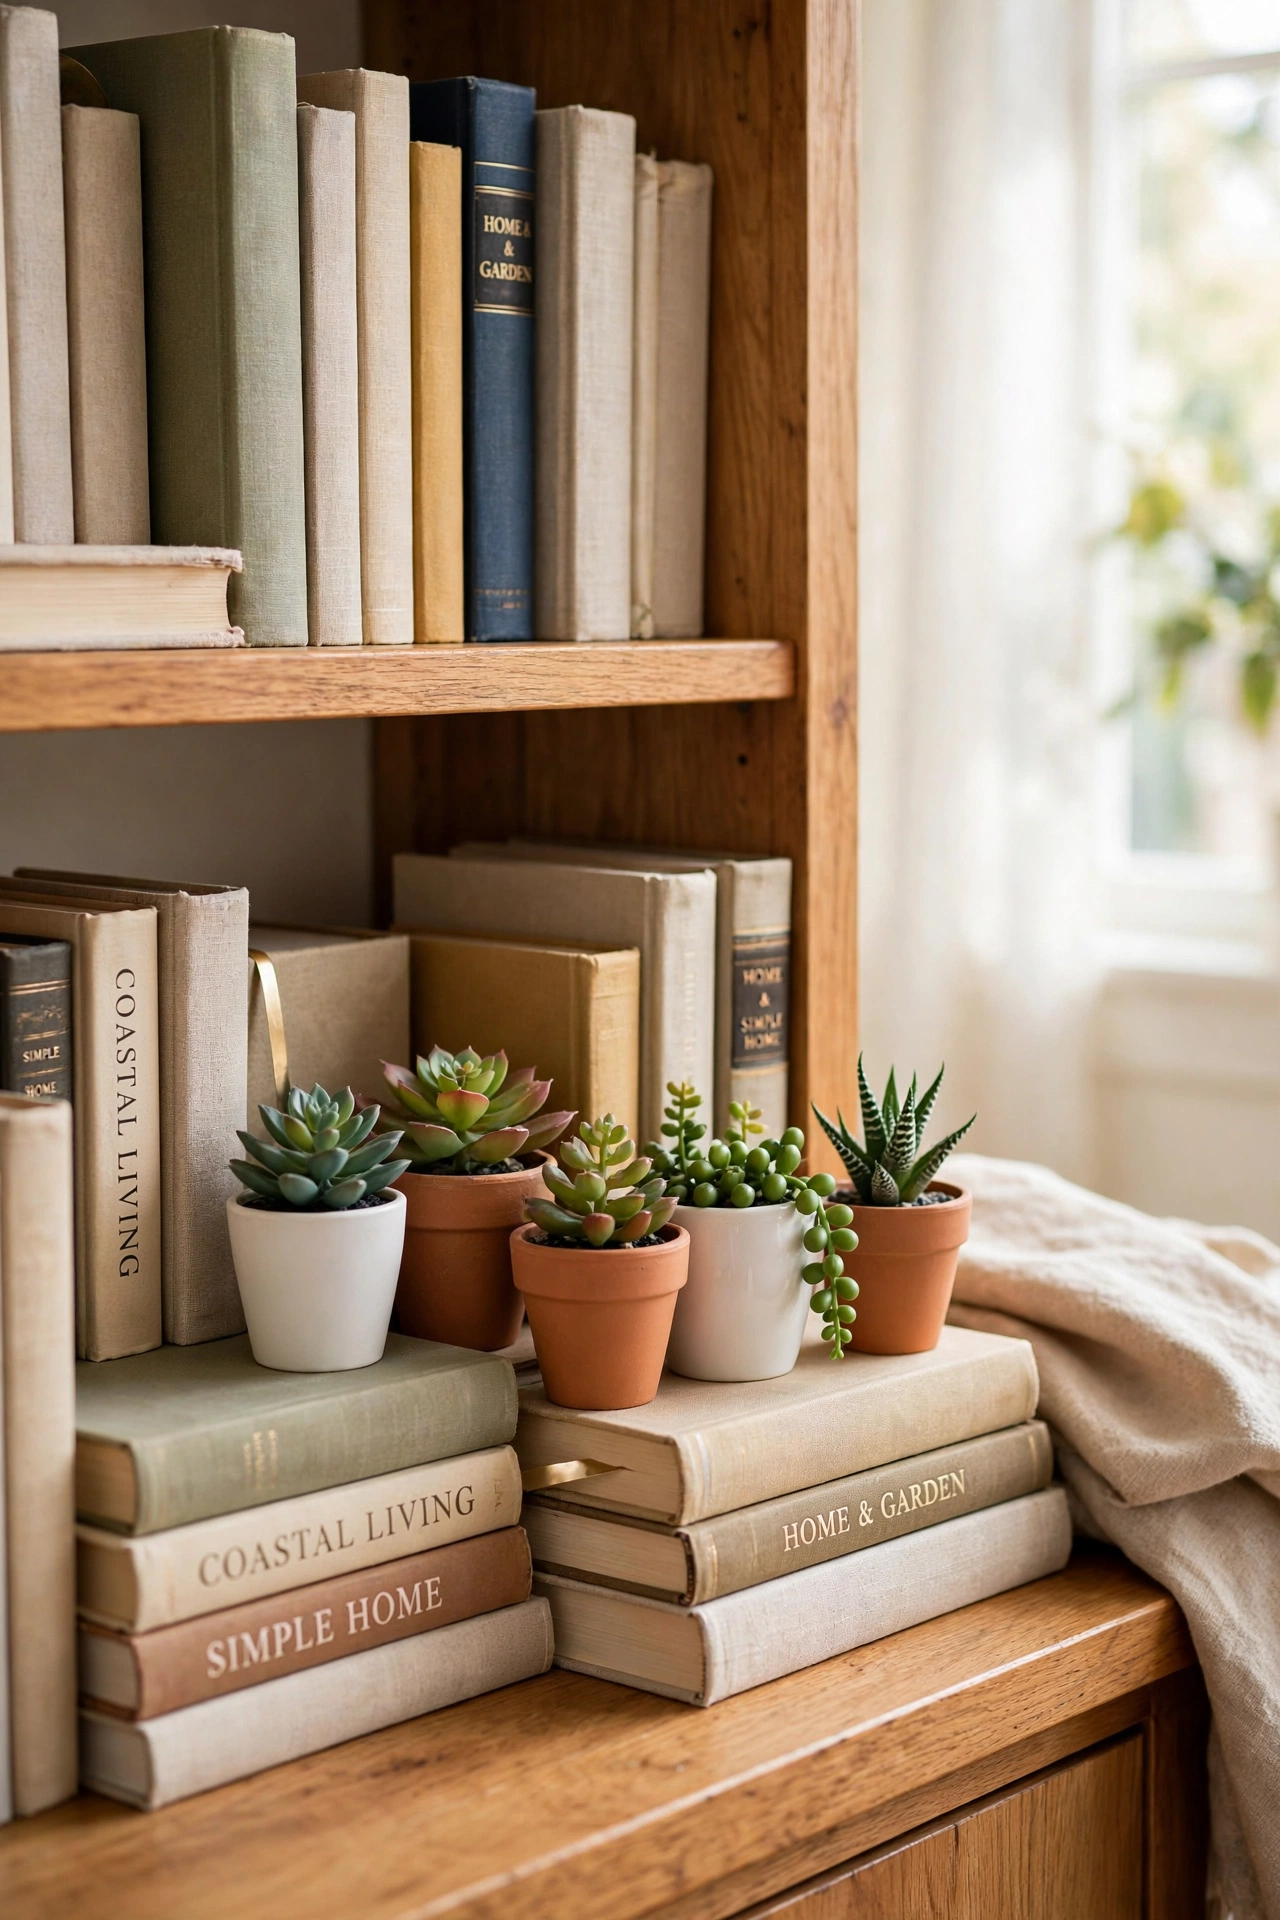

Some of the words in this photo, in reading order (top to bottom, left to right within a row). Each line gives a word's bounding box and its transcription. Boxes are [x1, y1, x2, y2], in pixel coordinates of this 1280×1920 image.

[483, 215, 522, 237] HOME
[503, 240, 515, 257] &
[479, 260, 532, 283] GARDEN
[23, 1046, 60, 1063] SIMPLE
[115, 968, 138, 1137] COASTAL
[117, 1149, 140, 1279] LIVING
[198, 1519, 354, 1587] COASTAL
[366, 1485, 475, 1542] LIVING
[782, 1506, 850, 1552] HOME
[858, 1500, 874, 1527] &
[880, 1469, 965, 1519] GARDEN
[206, 1608, 335, 1679] SIMPLE
[346, 1576, 443, 1636] HOME
